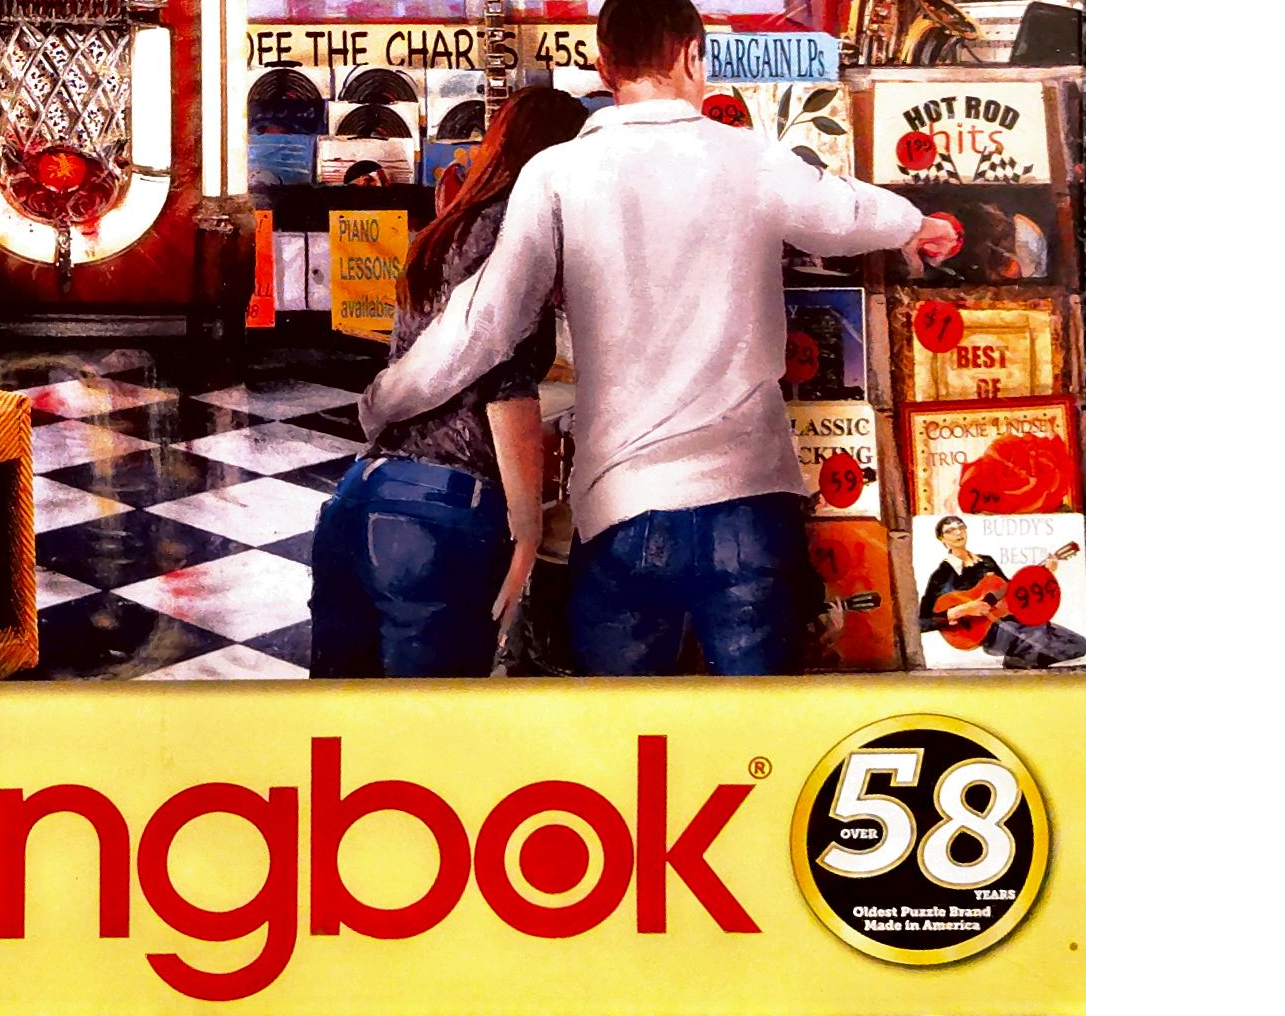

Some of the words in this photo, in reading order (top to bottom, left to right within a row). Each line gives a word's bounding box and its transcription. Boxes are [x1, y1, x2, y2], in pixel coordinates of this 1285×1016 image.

[305, 30, 369, 67] THE
[535, 31, 589, 68] 45s
[710, 38, 795, 80] BARGAIN
[797, 40, 826, 79] LPs
[902, 96, 957, 132] HOT
[964, 96, 1021, 131] ROD
[928, 121, 1005, 156] hits
[338, 218, 380, 243] PIANO
[339, 255, 402, 281] LESSONS
[956, 345, 1010, 369] BEST
[790, 417, 871, 437] LASSIC
[925, 419, 989, 441] COOKIE
[982, 517, 1055, 536] BUDDY'S
[815, 747, 1024, 891] 58
[840, 828, 879, 840] OVER
[973, 889, 1016, 901] YEARS
[852, 905, 898, 918] Oldest
[900, 905, 947, 918] Puzzle
[949, 905, 992, 918] Brand
[864, 918, 903, 932] Made
[904, 918, 921, 932] in
[921, 918, 981, 932] America
